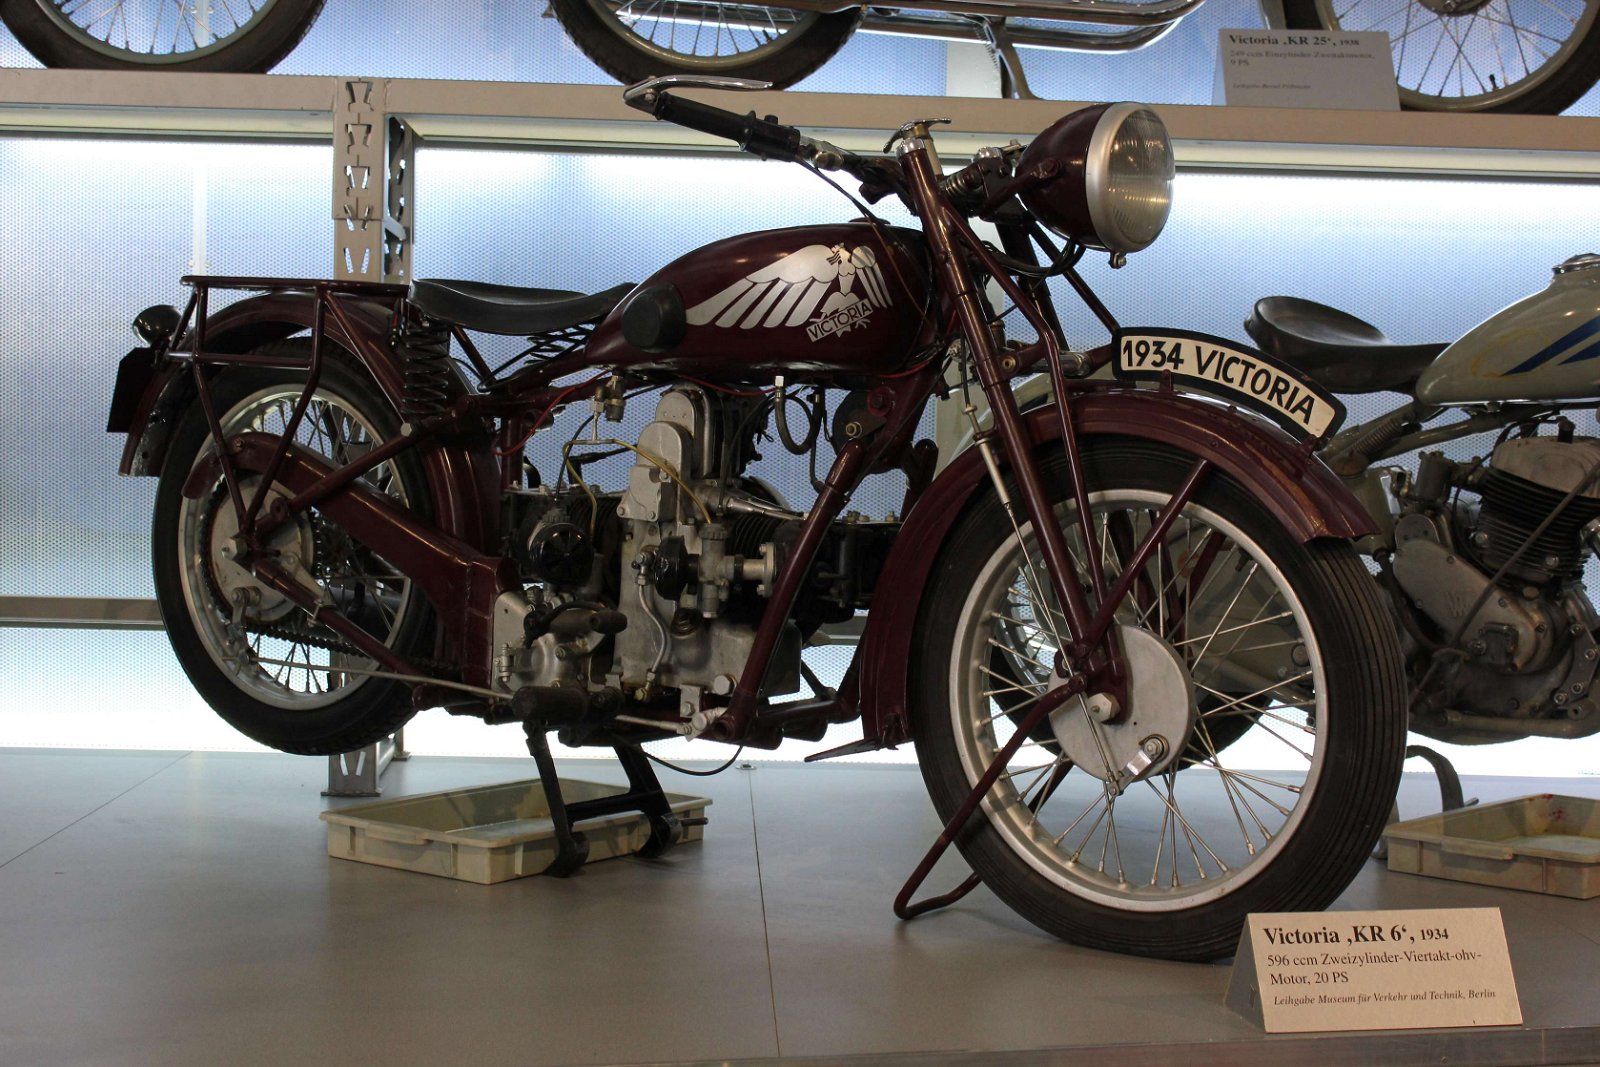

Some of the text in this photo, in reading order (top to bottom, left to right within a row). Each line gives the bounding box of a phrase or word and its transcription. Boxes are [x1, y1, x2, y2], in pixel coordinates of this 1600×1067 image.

[1228, 34, 1279, 46] Victoria
[808, 301, 872, 339] VICTORIA
[1122, 340, 1316, 425] 1934 VICTORIA
[1262, 926, 1341, 945] Victoria
[1420, 928, 1449, 941] 1934
[1267, 949, 1482, 967] 596 ccm Zweizylinder-Viertakt-ohv-
[1270, 971, 1349, 985] Motor, 20 PS
[1274, 989, 1496, 1006] Leihgabe Museum für Verkehr und Technik, Berlin
